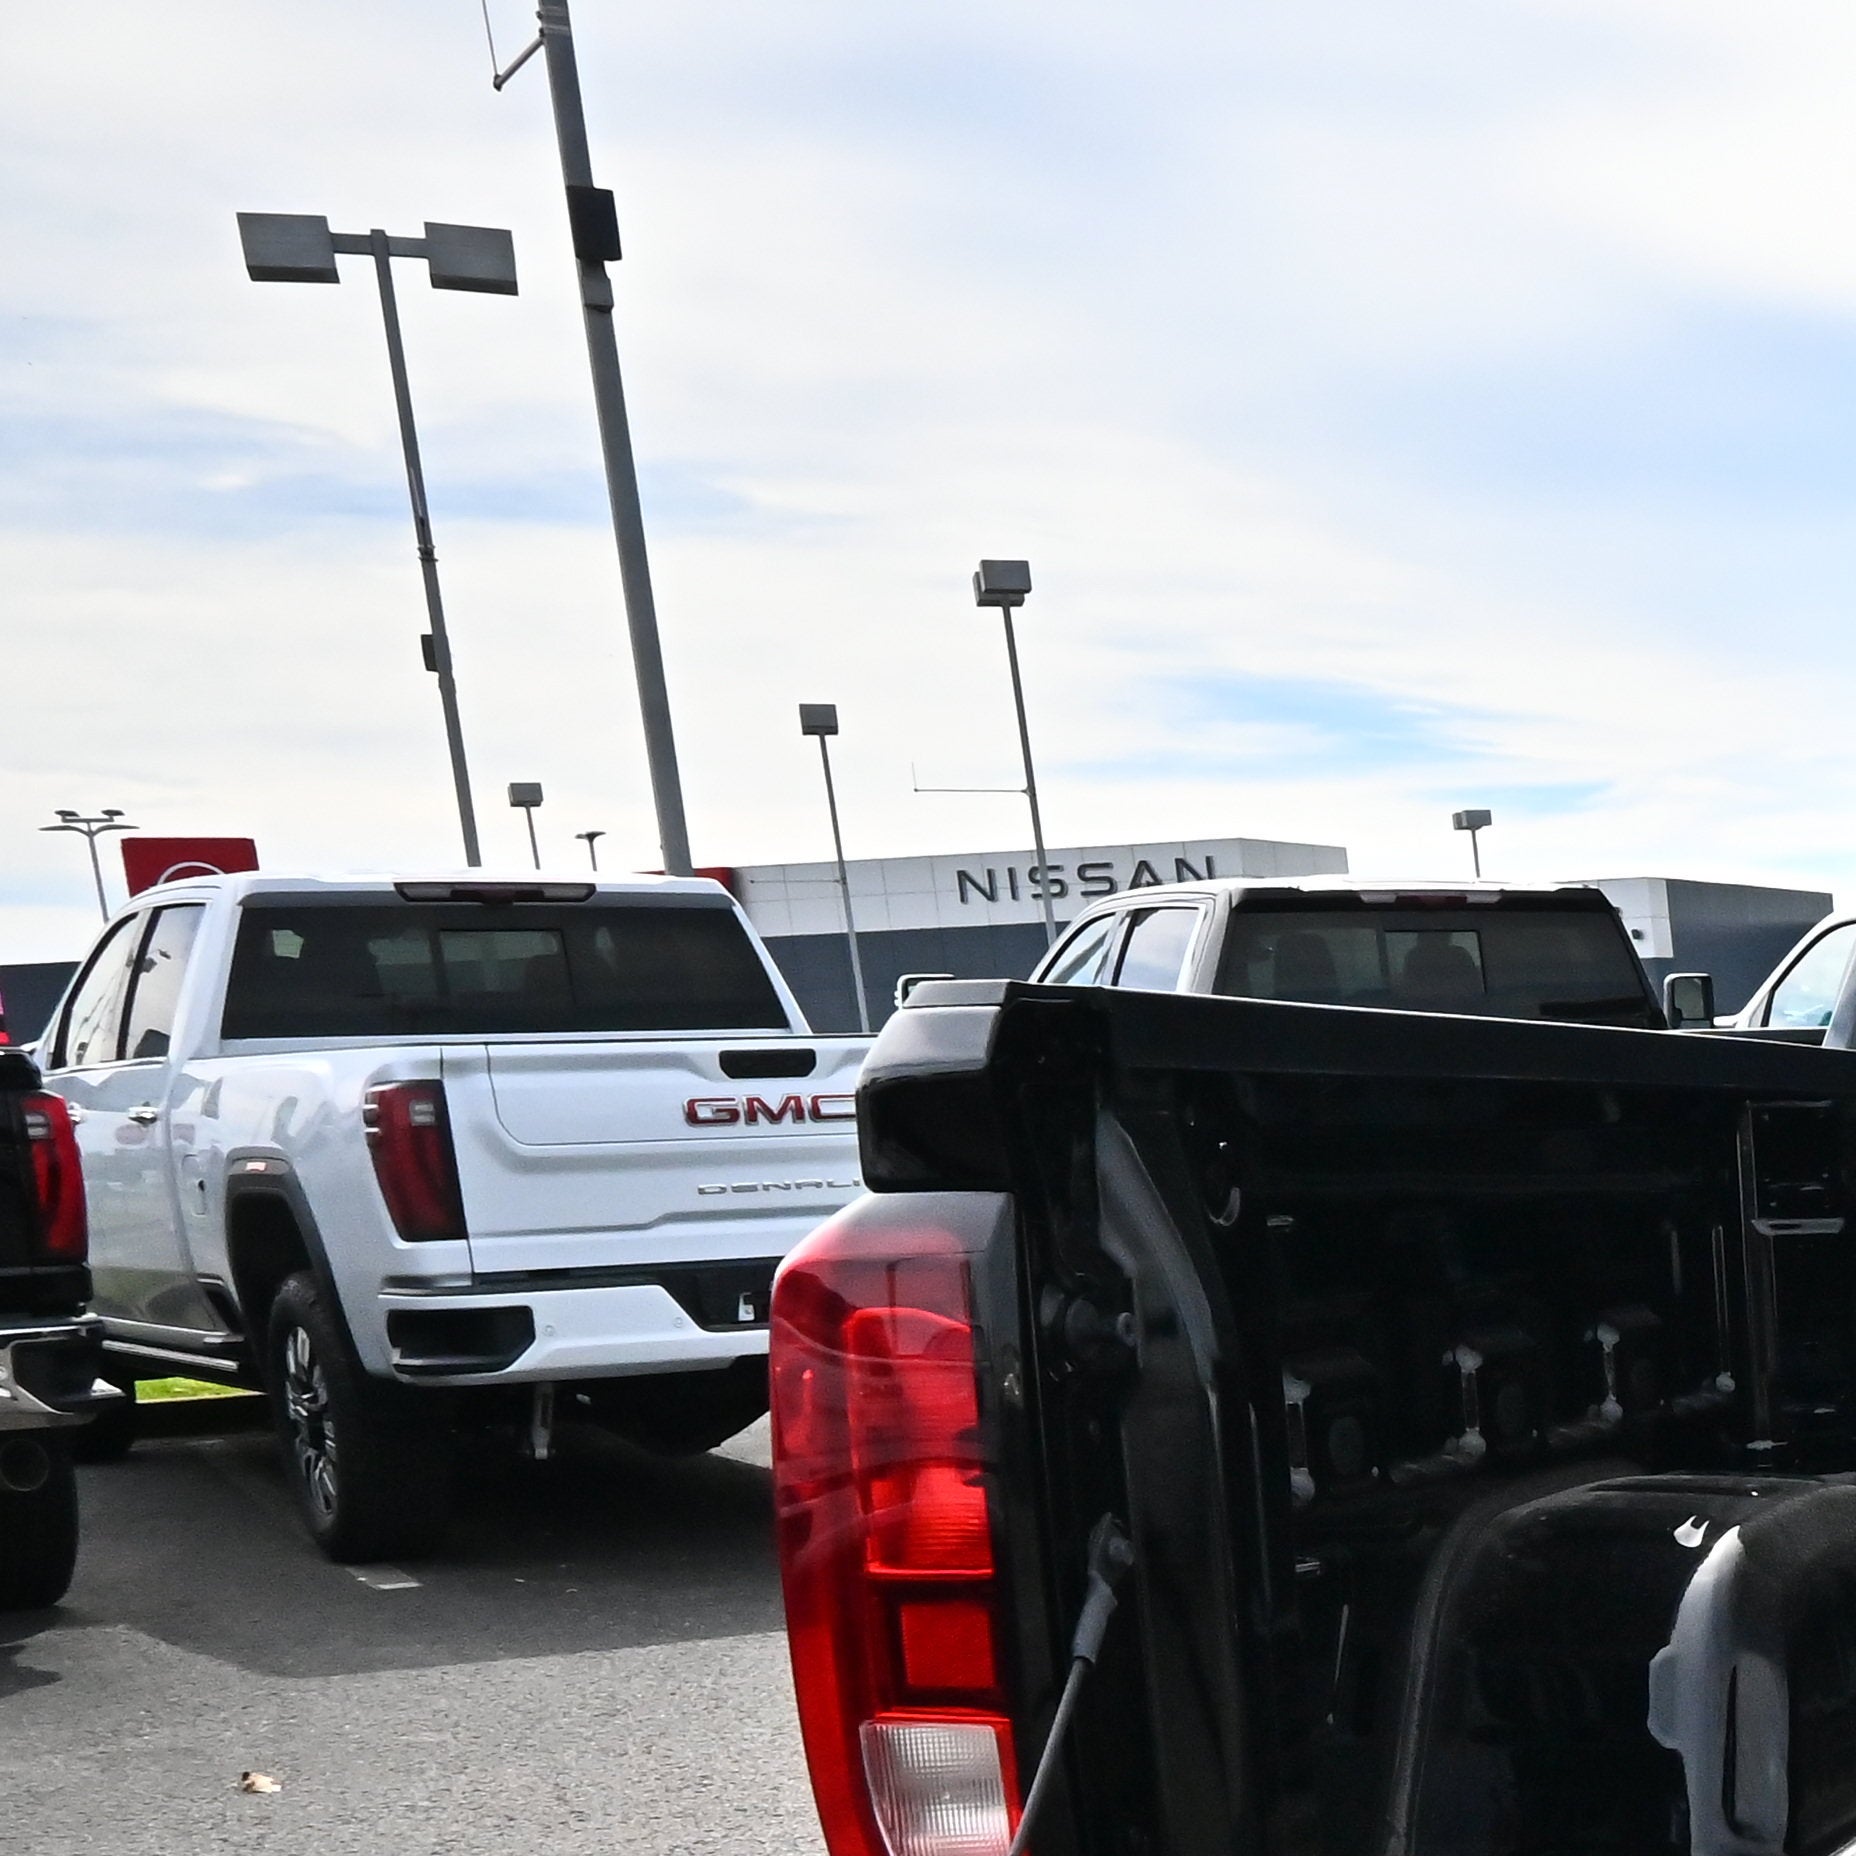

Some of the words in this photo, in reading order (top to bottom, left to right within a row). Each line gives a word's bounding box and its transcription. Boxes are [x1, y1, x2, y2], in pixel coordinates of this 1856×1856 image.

[956, 855, 1217, 905] NISSAN
[683, 1092, 857, 1127] GMC
[697, 1178, 861, 1196] DENALI
